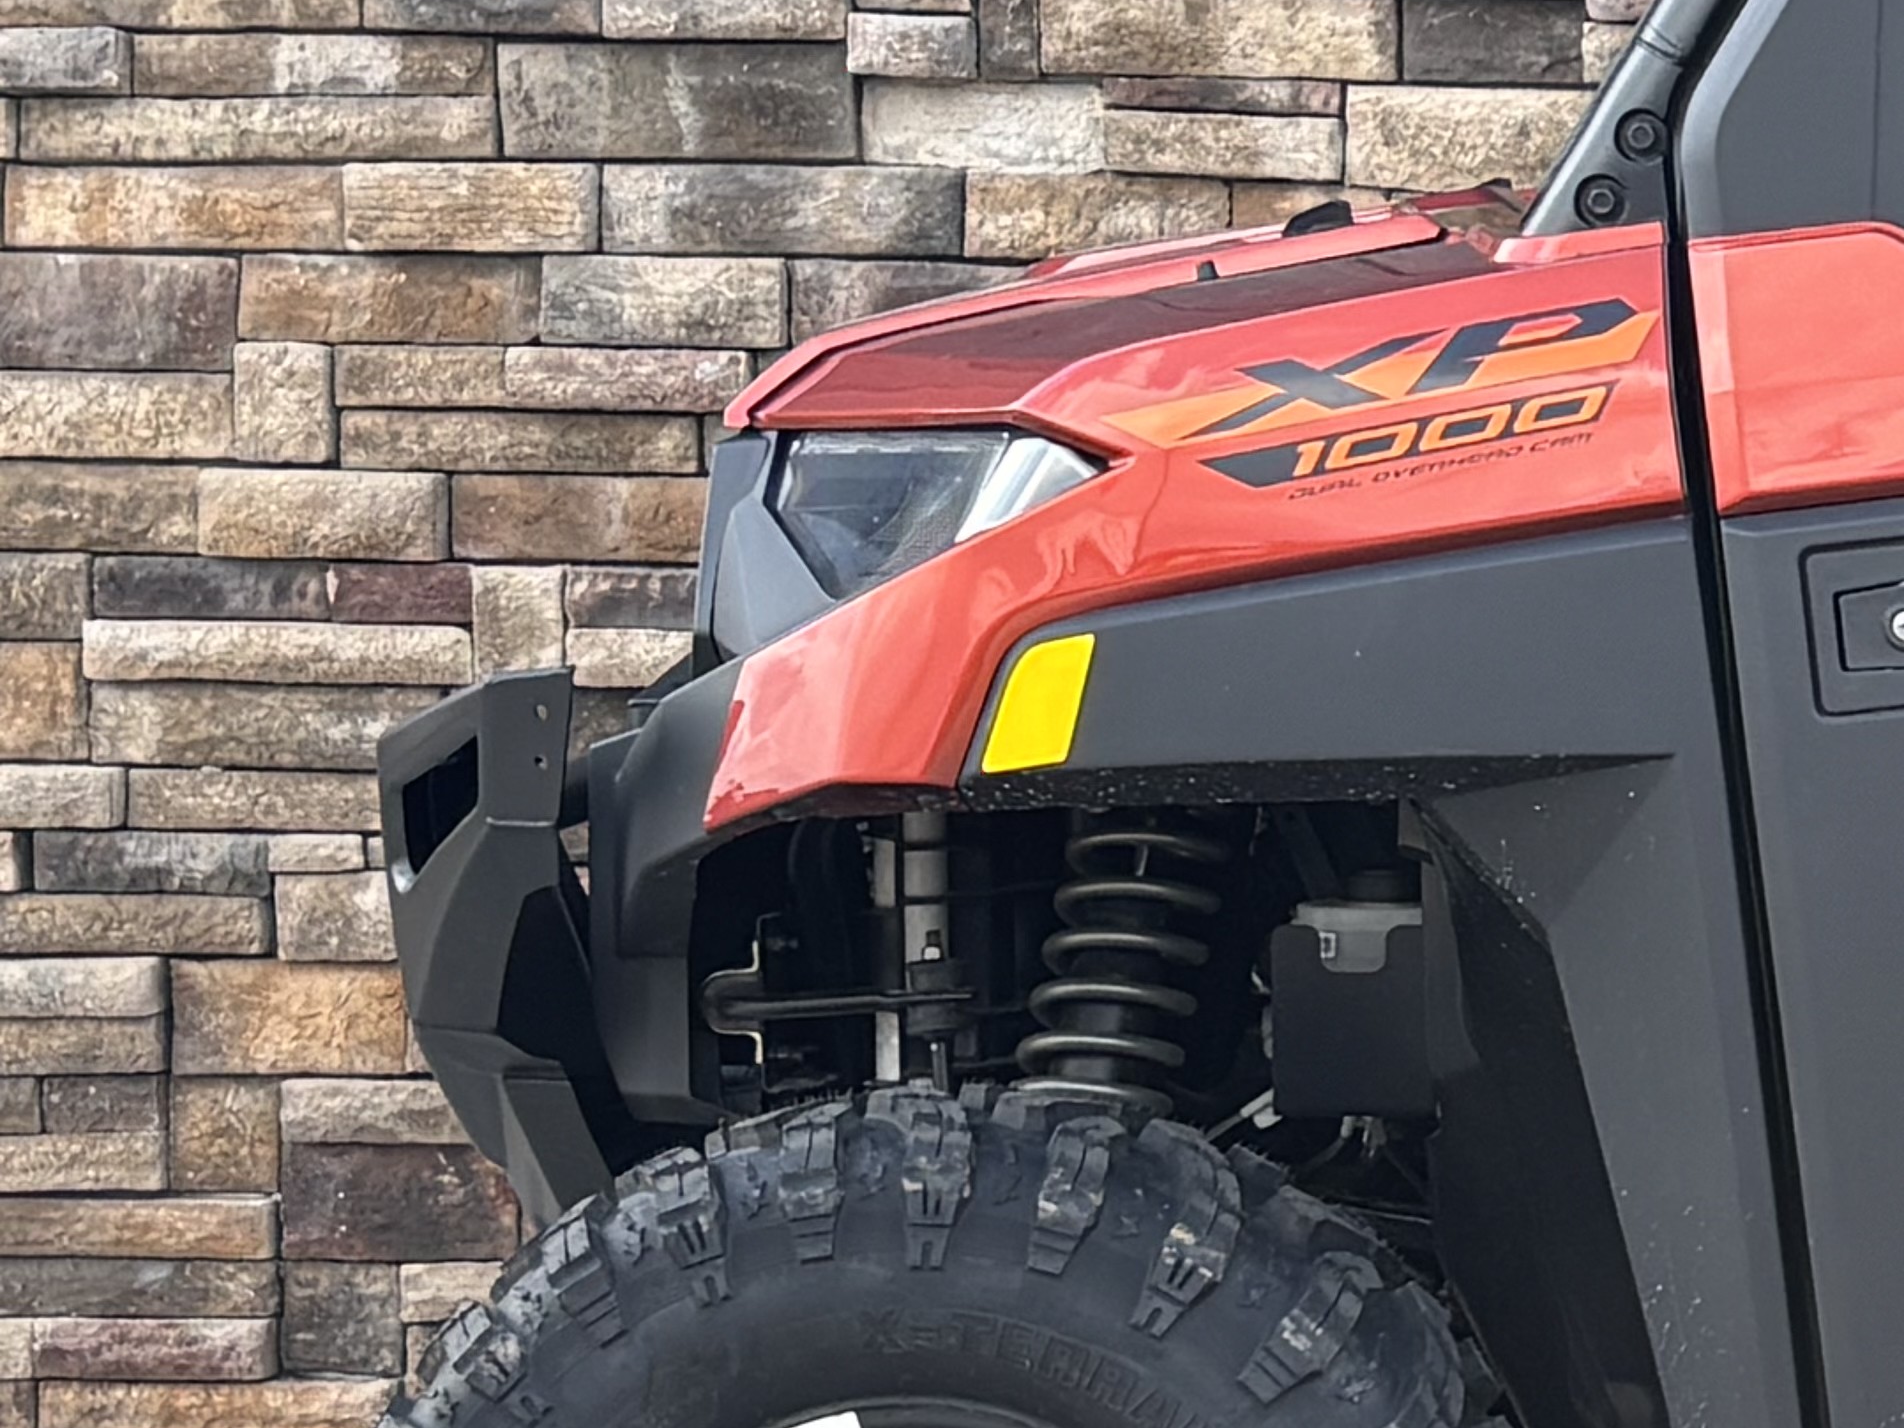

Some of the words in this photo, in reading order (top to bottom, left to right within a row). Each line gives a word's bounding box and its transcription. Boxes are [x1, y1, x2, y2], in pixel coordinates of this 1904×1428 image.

[1179, 296, 1640, 440] XP
[1288, 476, 1362, 500] DUAL
[1371, 444, 1523, 484] OVERHEAD
[1291, 383, 1613, 477] 1000
